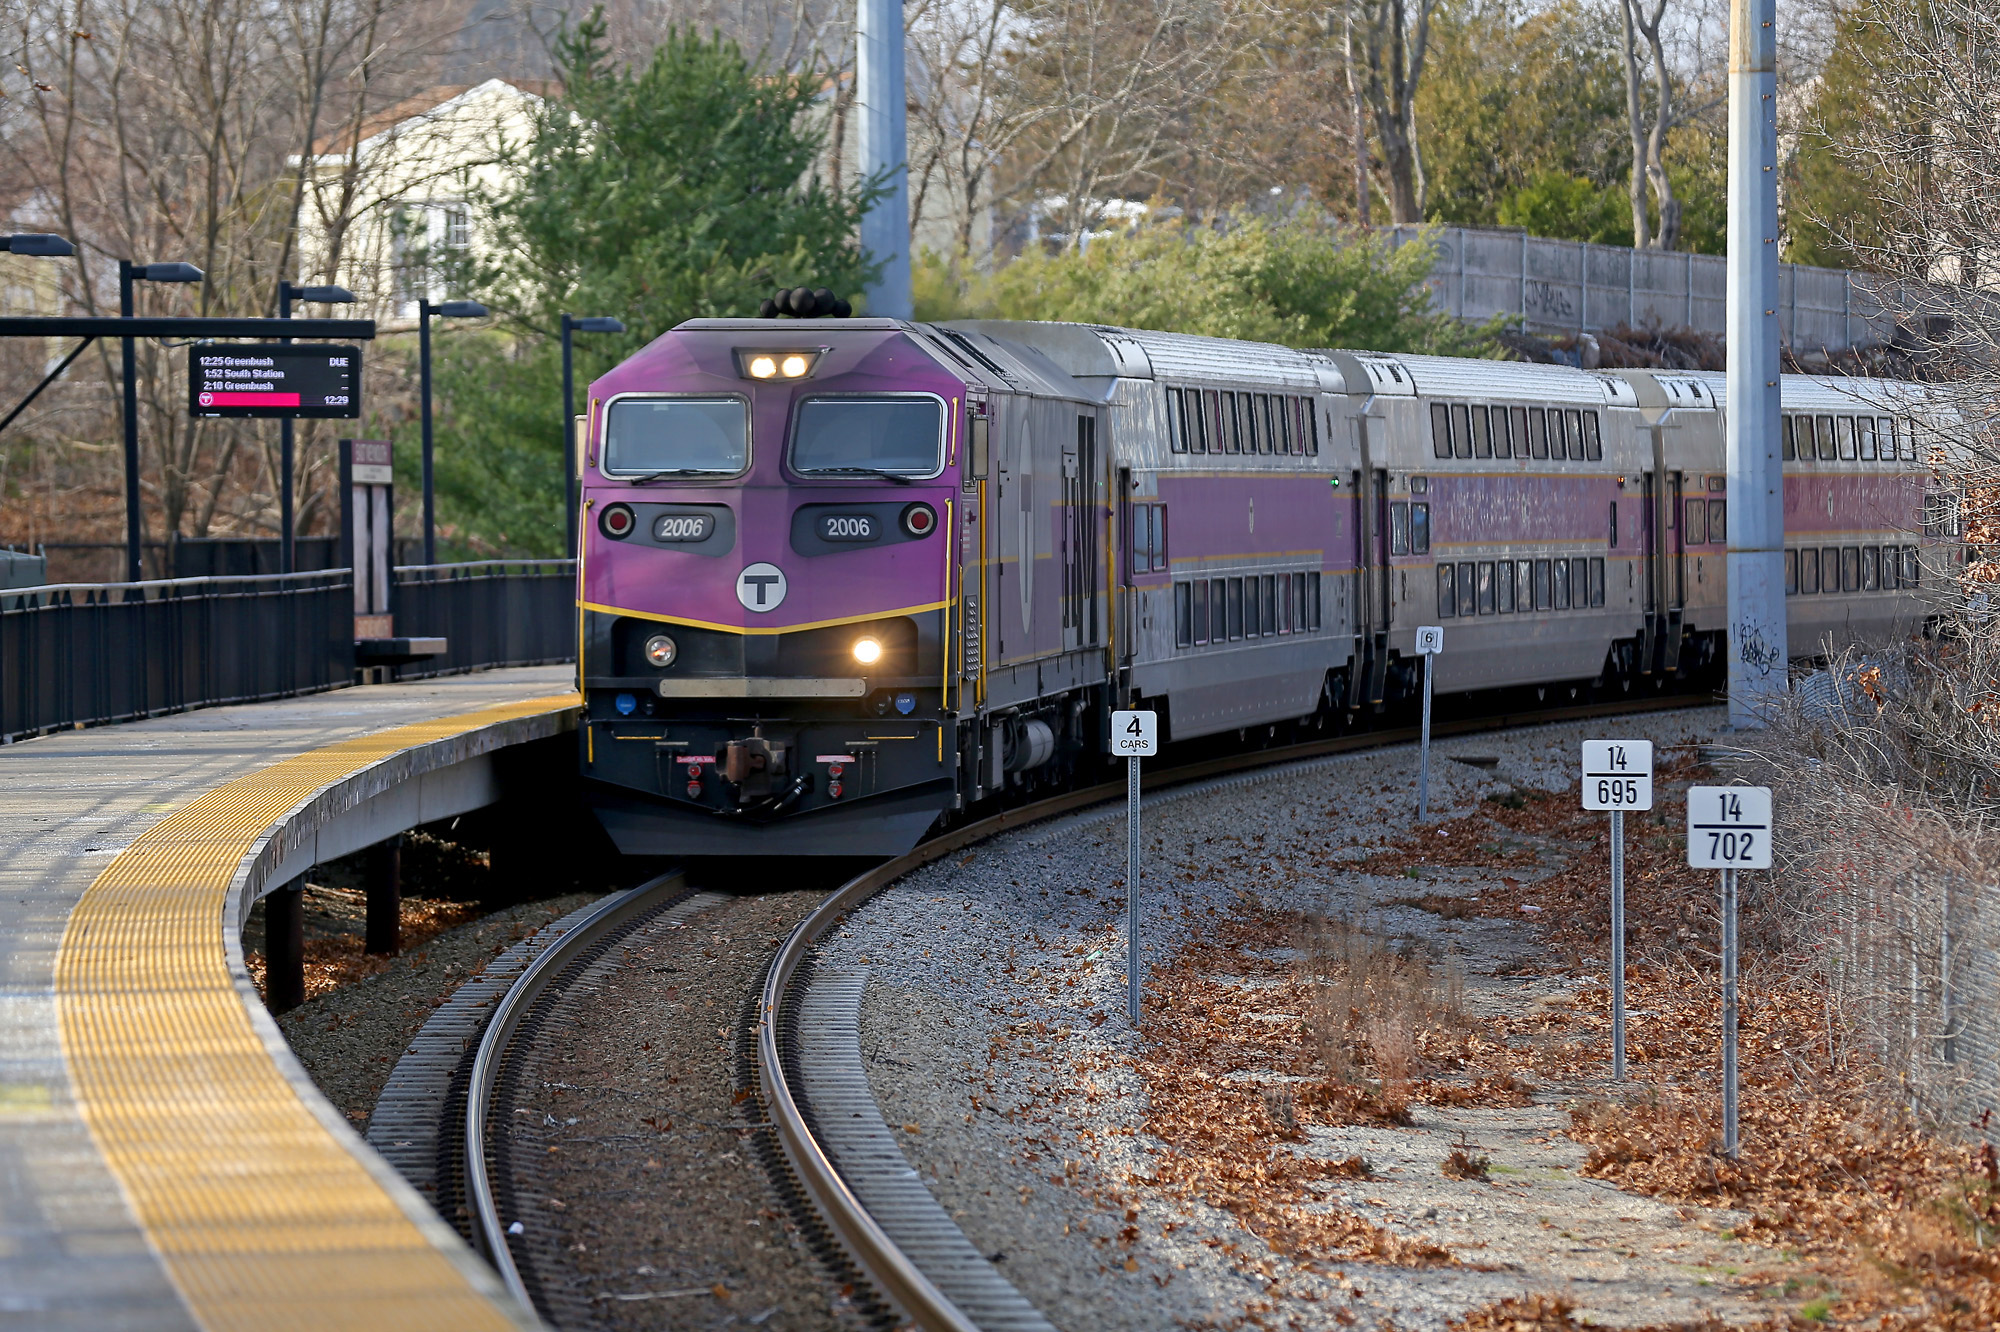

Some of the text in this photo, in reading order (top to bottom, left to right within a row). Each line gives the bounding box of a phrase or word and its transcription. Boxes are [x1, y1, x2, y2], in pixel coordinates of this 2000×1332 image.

[200, 357, 273, 366] 12:25 Greenbush
[329, 358, 348, 367] DUE
[204, 369, 284, 378] 1:52 South Station
[224, 381, 273, 390] Greenbush
[324, 395, 349, 405] 12:29
[661, 519, 703, 536] 2006
[827, 519, 870, 536] 2006
[744, 575, 779, 605] T
[1425, 632, 1433, 643] 6
[1126, 717, 1143, 737] 4
[1120, 739, 1149, 749] CARS
[1607, 746, 1627, 770] 14
[1598, 780, 1637, 804] 695
[1719, 793, 1742, 822] 14
[1708, 832, 1753, 861] 702
